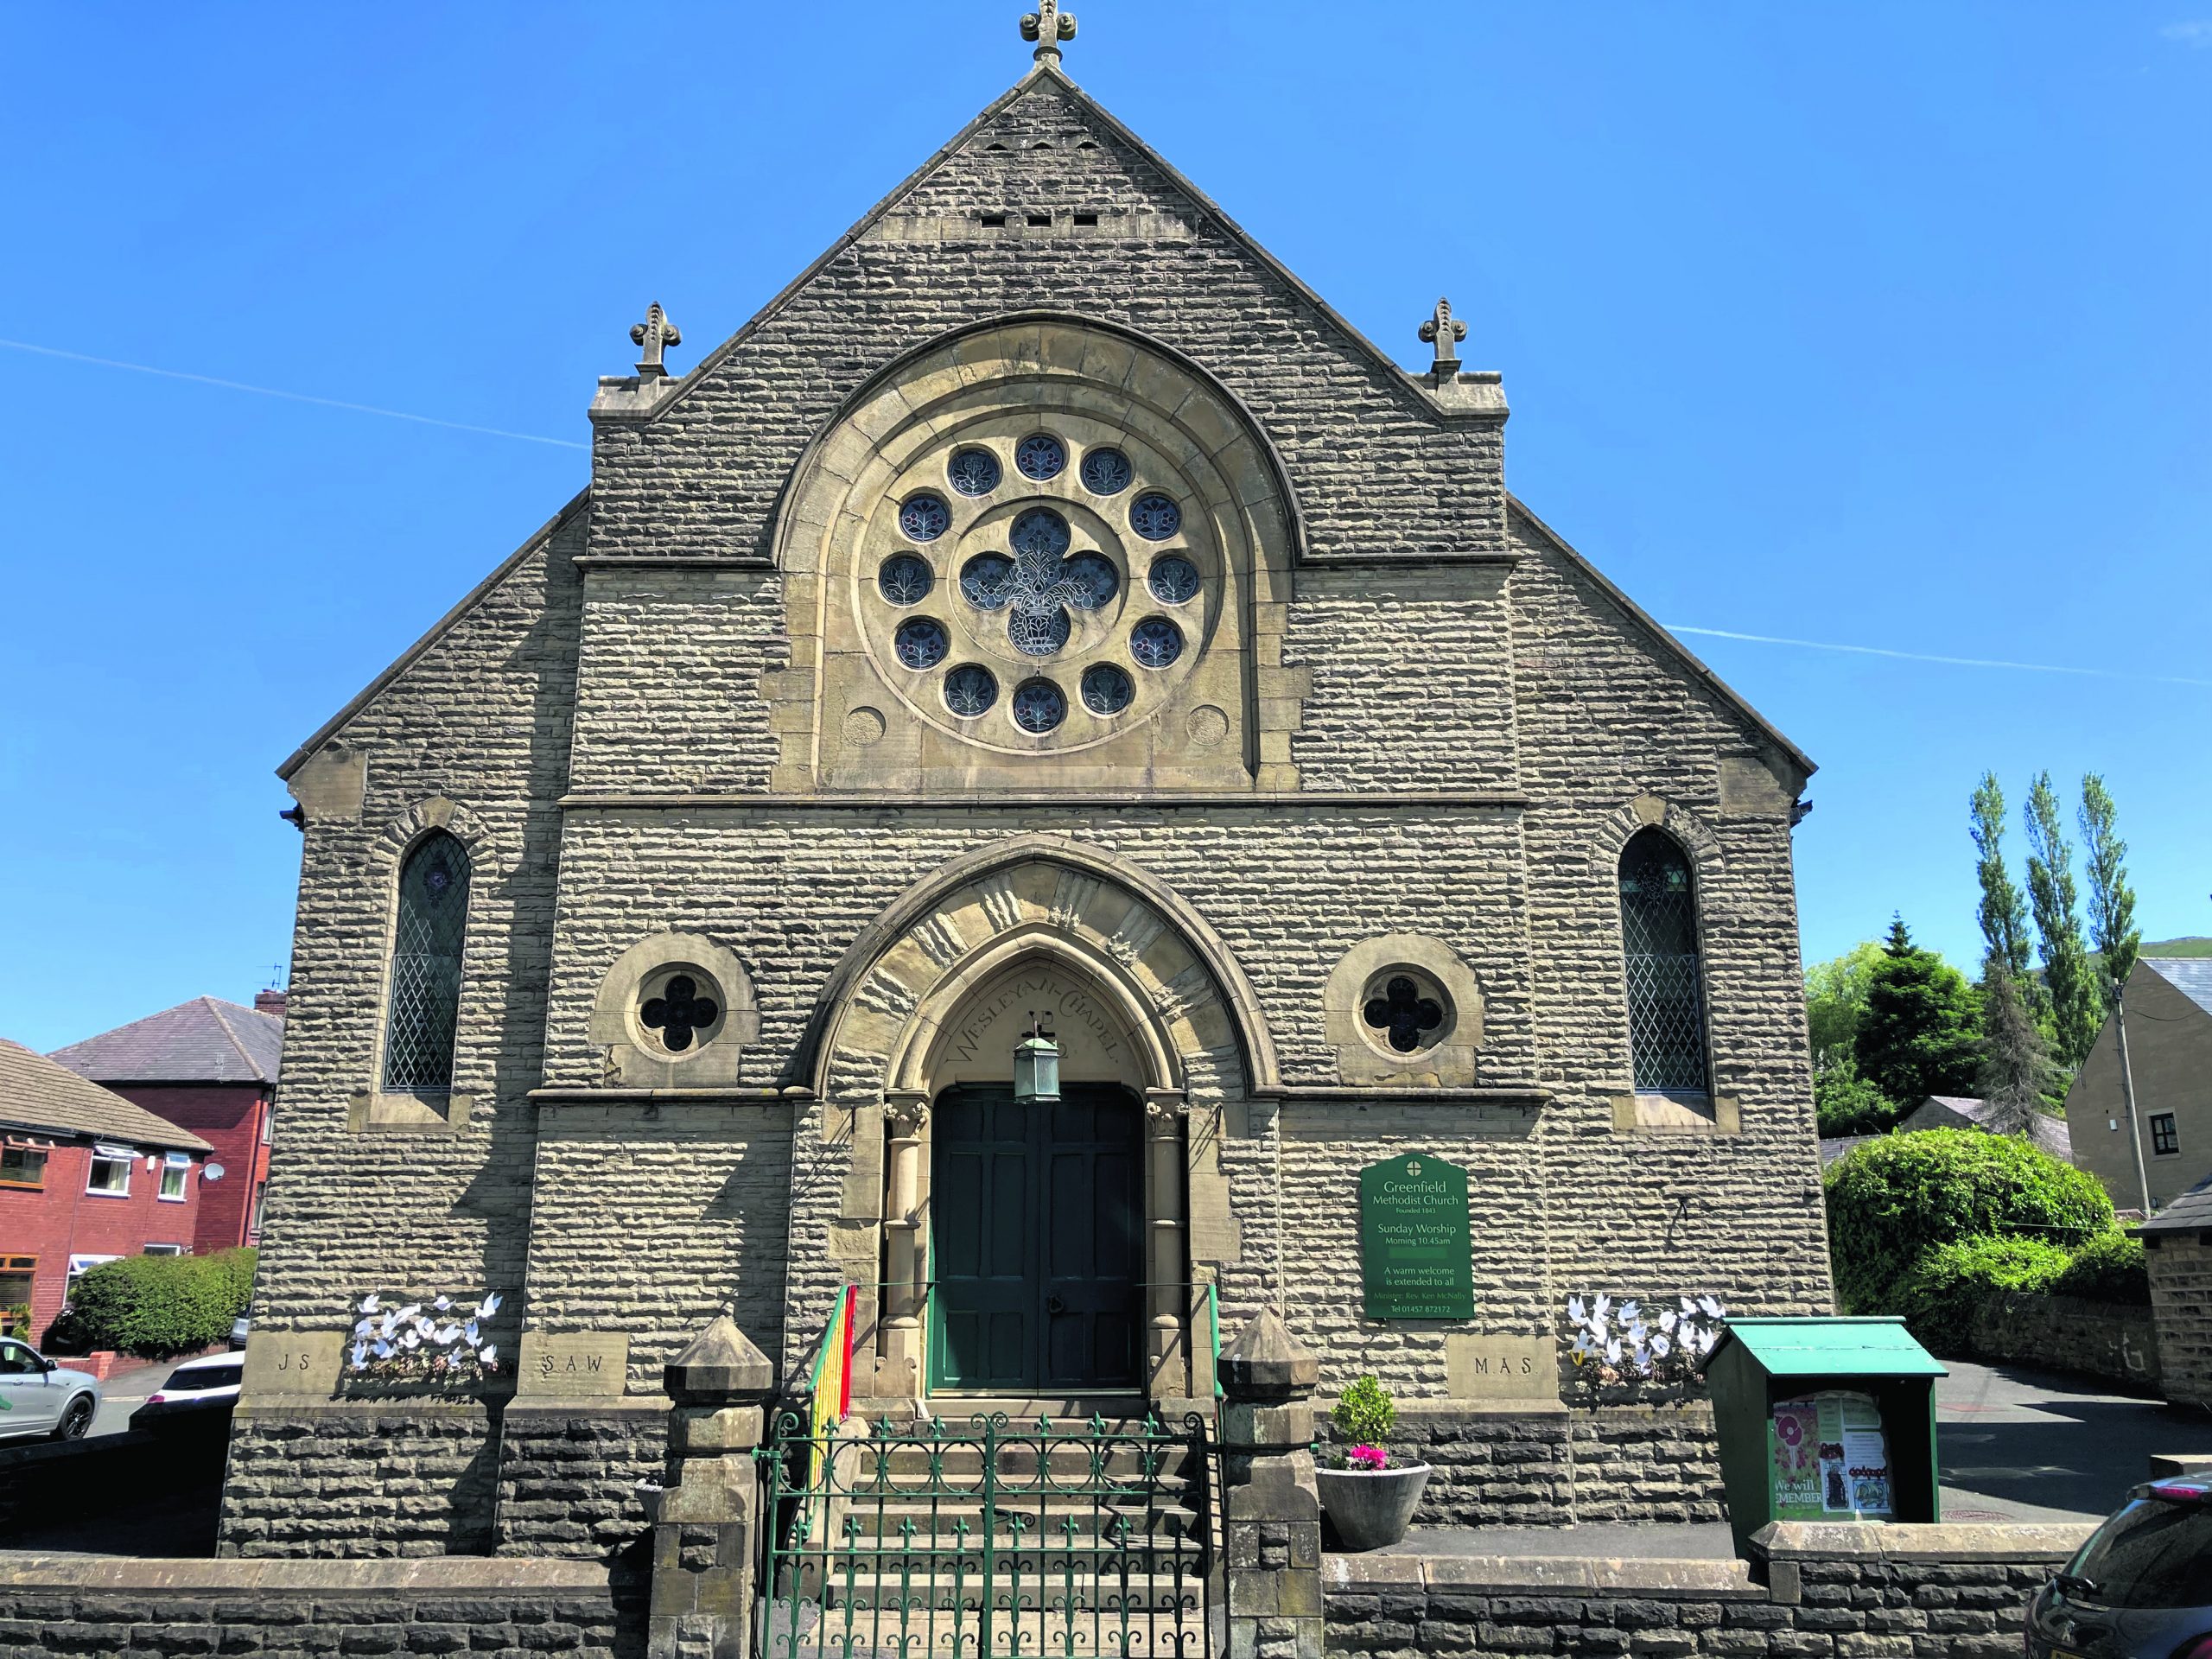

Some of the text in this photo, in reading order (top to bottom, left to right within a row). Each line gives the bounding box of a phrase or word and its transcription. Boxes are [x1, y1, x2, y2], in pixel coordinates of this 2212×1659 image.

[1384, 1181, 1446, 1193] Greenfield
[1373, 1196, 1459, 1205] Methodist Church
[1378, 1224, 1457, 1236] Sunday Worship
[1385, 1237, 1416, 1246] Morning
[1418, 1267, 1454, 1275] welcome
[1445, 1277, 1454, 1286] all
[1775, 1479, 1815, 1491] We will
